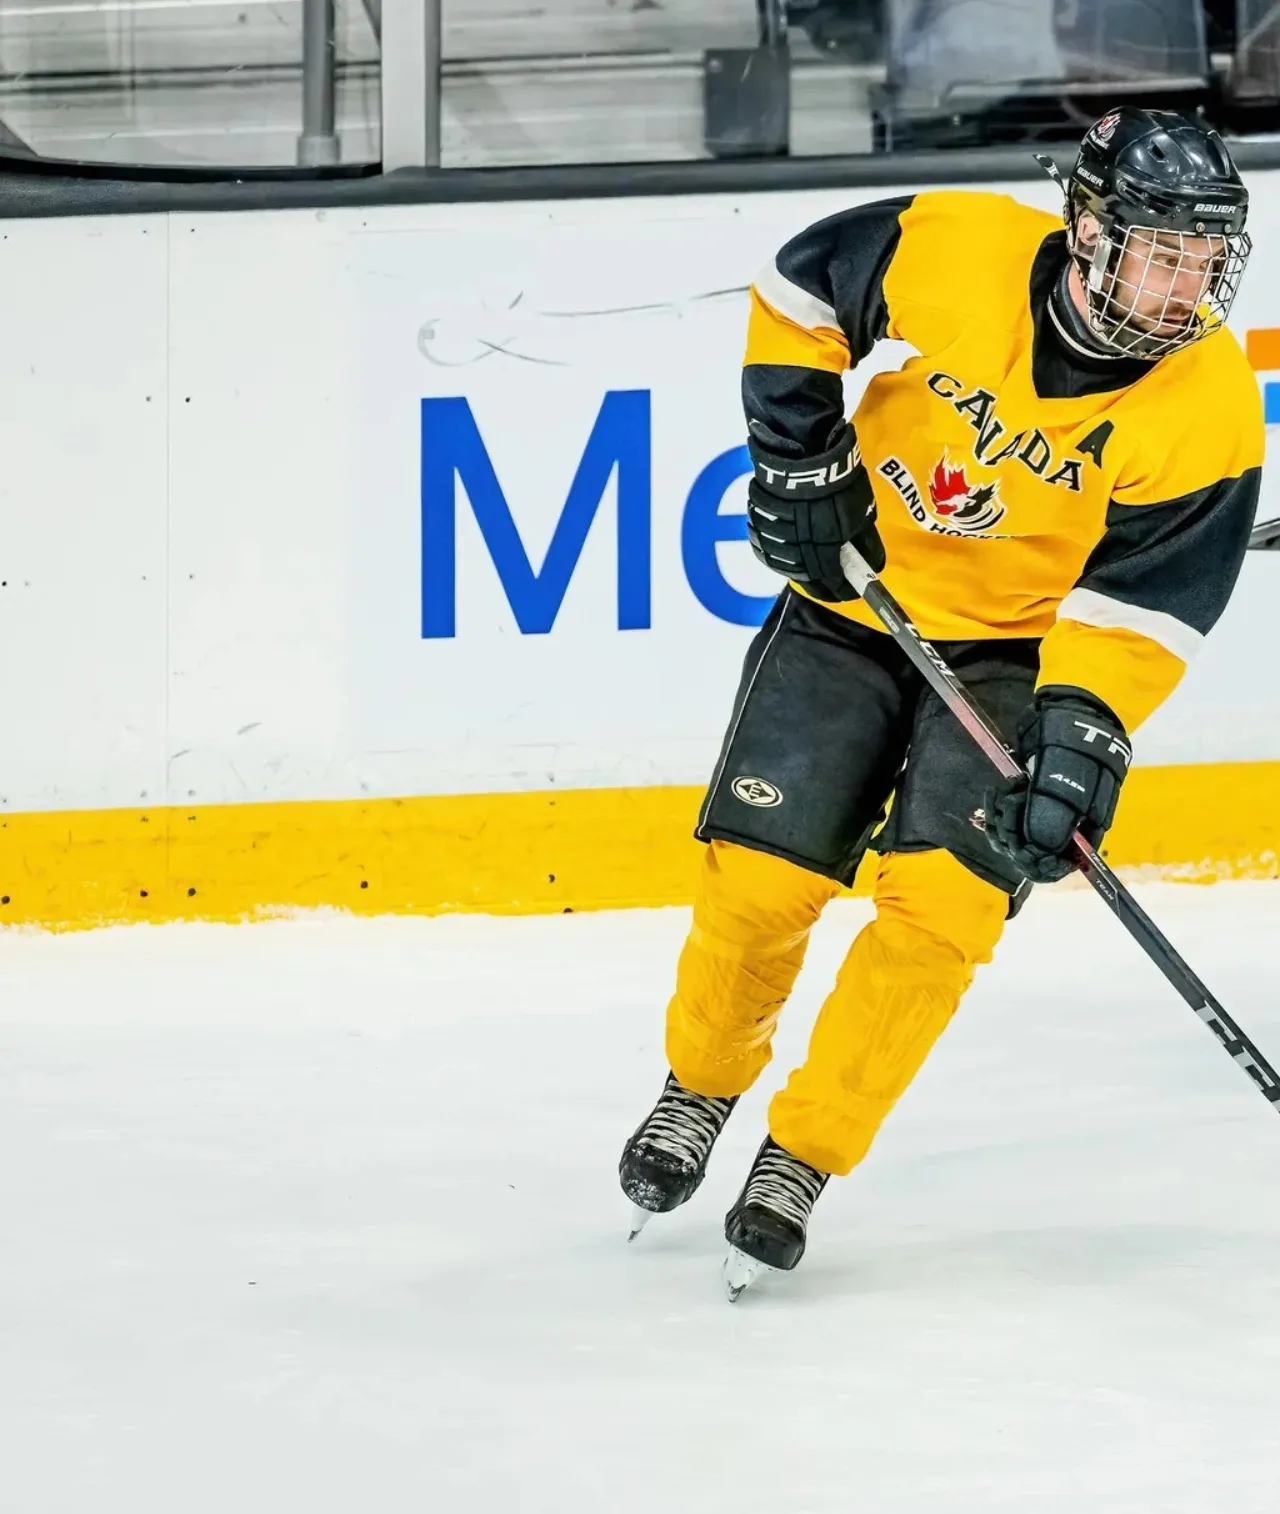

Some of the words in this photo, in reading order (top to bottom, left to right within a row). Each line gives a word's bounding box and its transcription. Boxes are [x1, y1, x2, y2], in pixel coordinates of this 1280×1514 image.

[1076, 166, 1105, 187] BAUER
[1193, 203, 1237, 214] BAUER
[1075, 419, 1115, 470] A
[879, 458, 927, 524] BLIND
